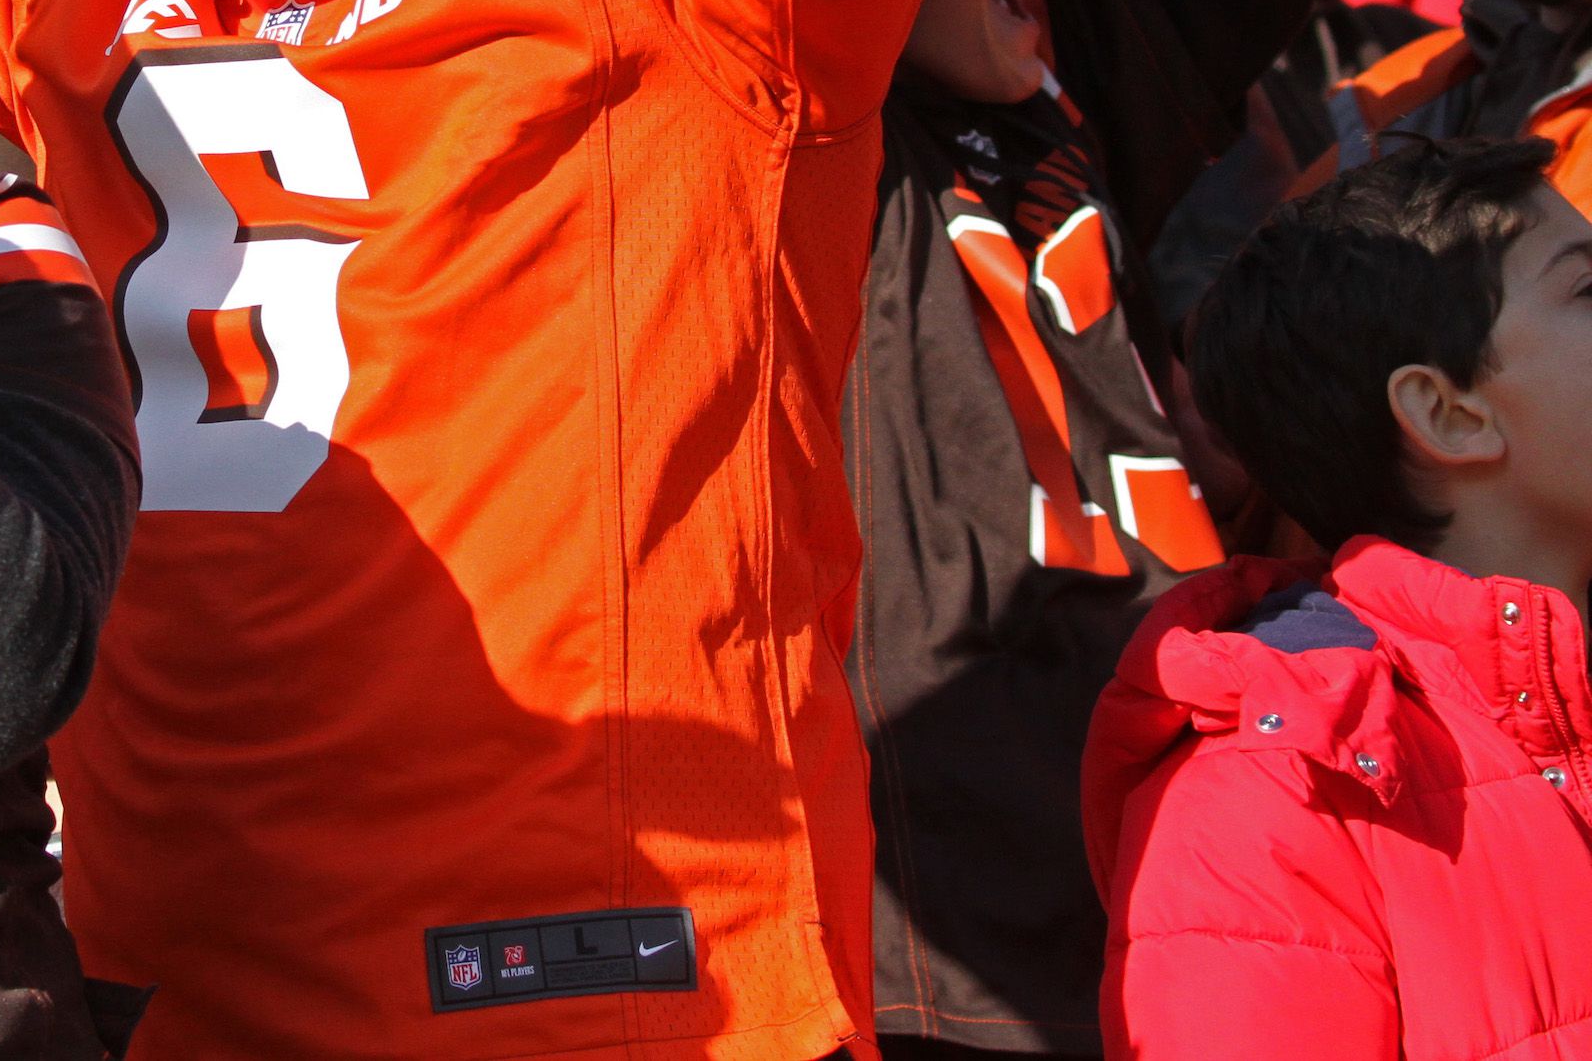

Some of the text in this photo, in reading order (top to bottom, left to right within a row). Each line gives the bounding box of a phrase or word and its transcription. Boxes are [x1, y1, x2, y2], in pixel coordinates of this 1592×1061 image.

[104, 41, 371, 514] 6
[573, 926, 600, 956] L
[449, 961, 478, 986] NFL
[510, 965, 536, 977] PLAYERS
